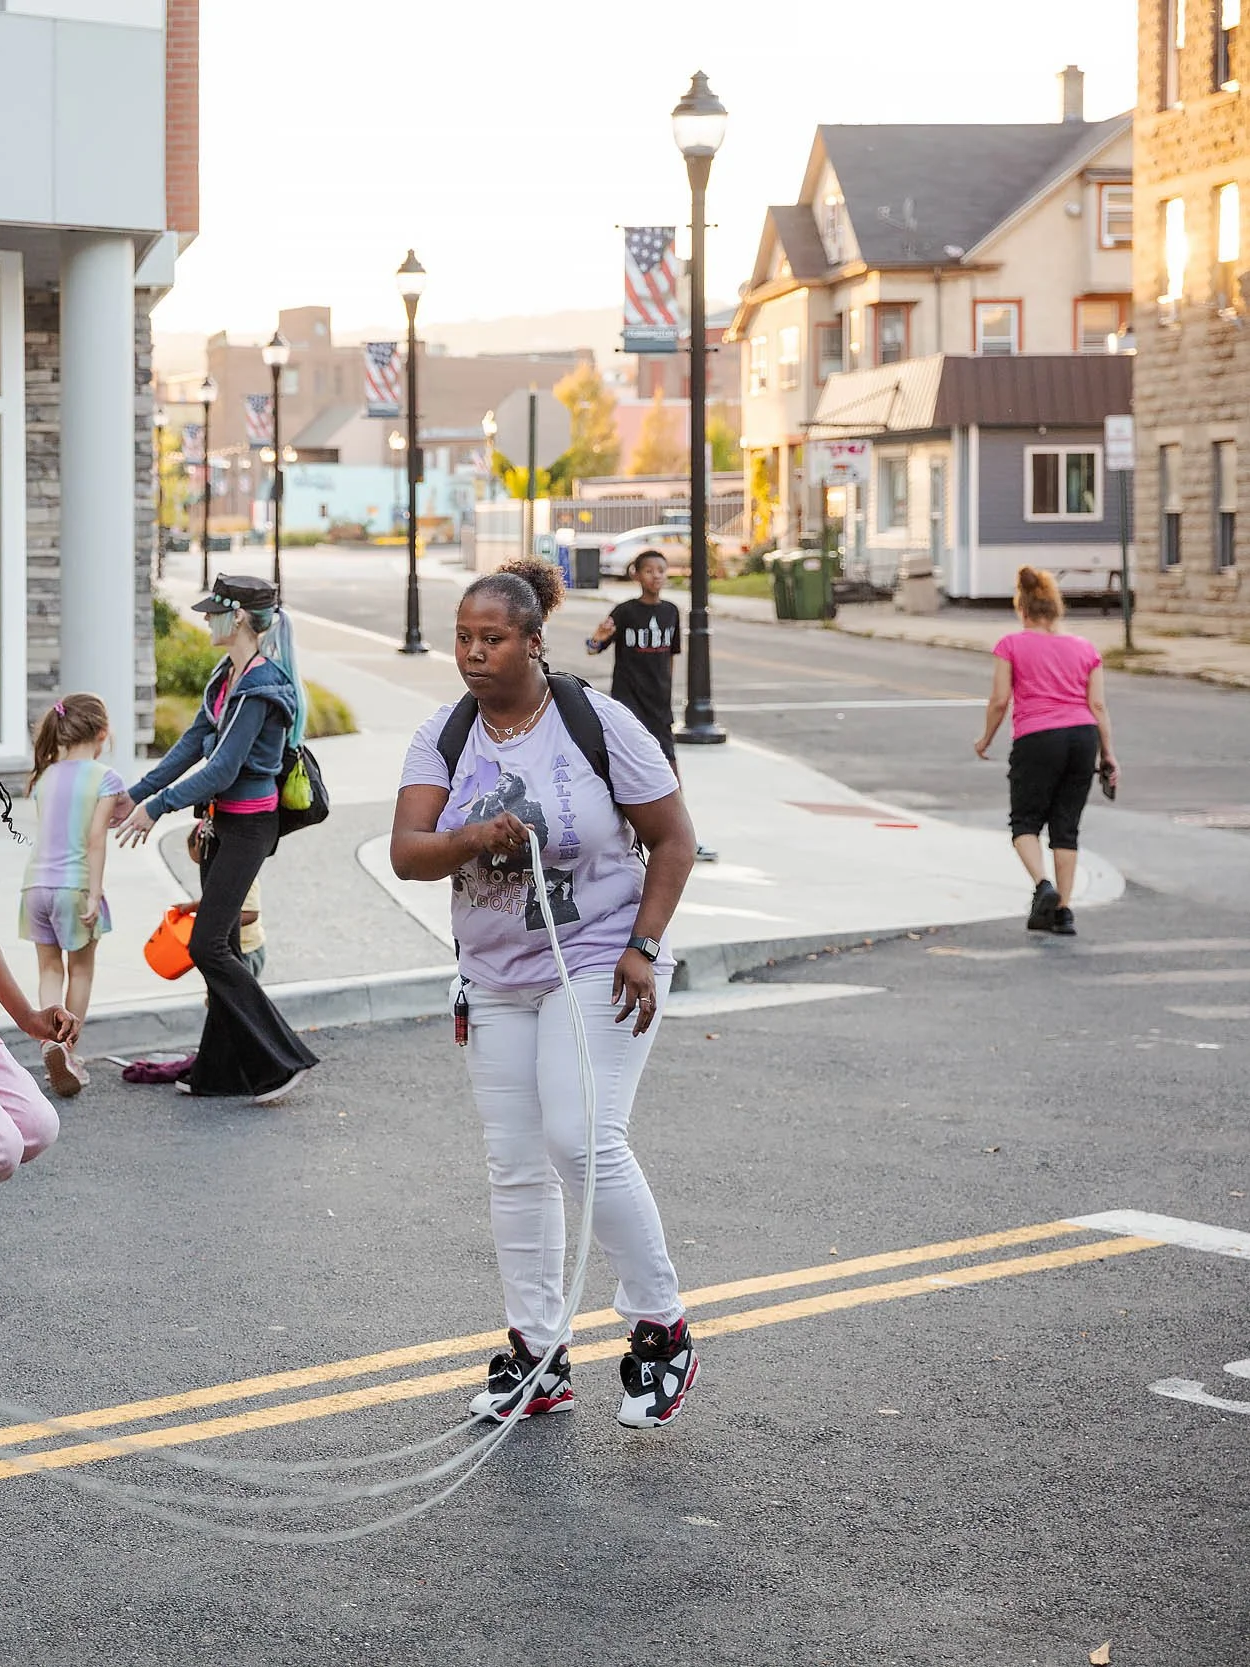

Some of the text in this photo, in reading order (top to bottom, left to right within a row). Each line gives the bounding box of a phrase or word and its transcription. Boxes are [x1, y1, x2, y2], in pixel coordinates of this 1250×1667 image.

[552, 754, 581, 860] AALIYAH
[477, 867, 534, 885] ROCK
[487, 883, 522, 900] THE
[477, 893, 525, 915] BOAT
